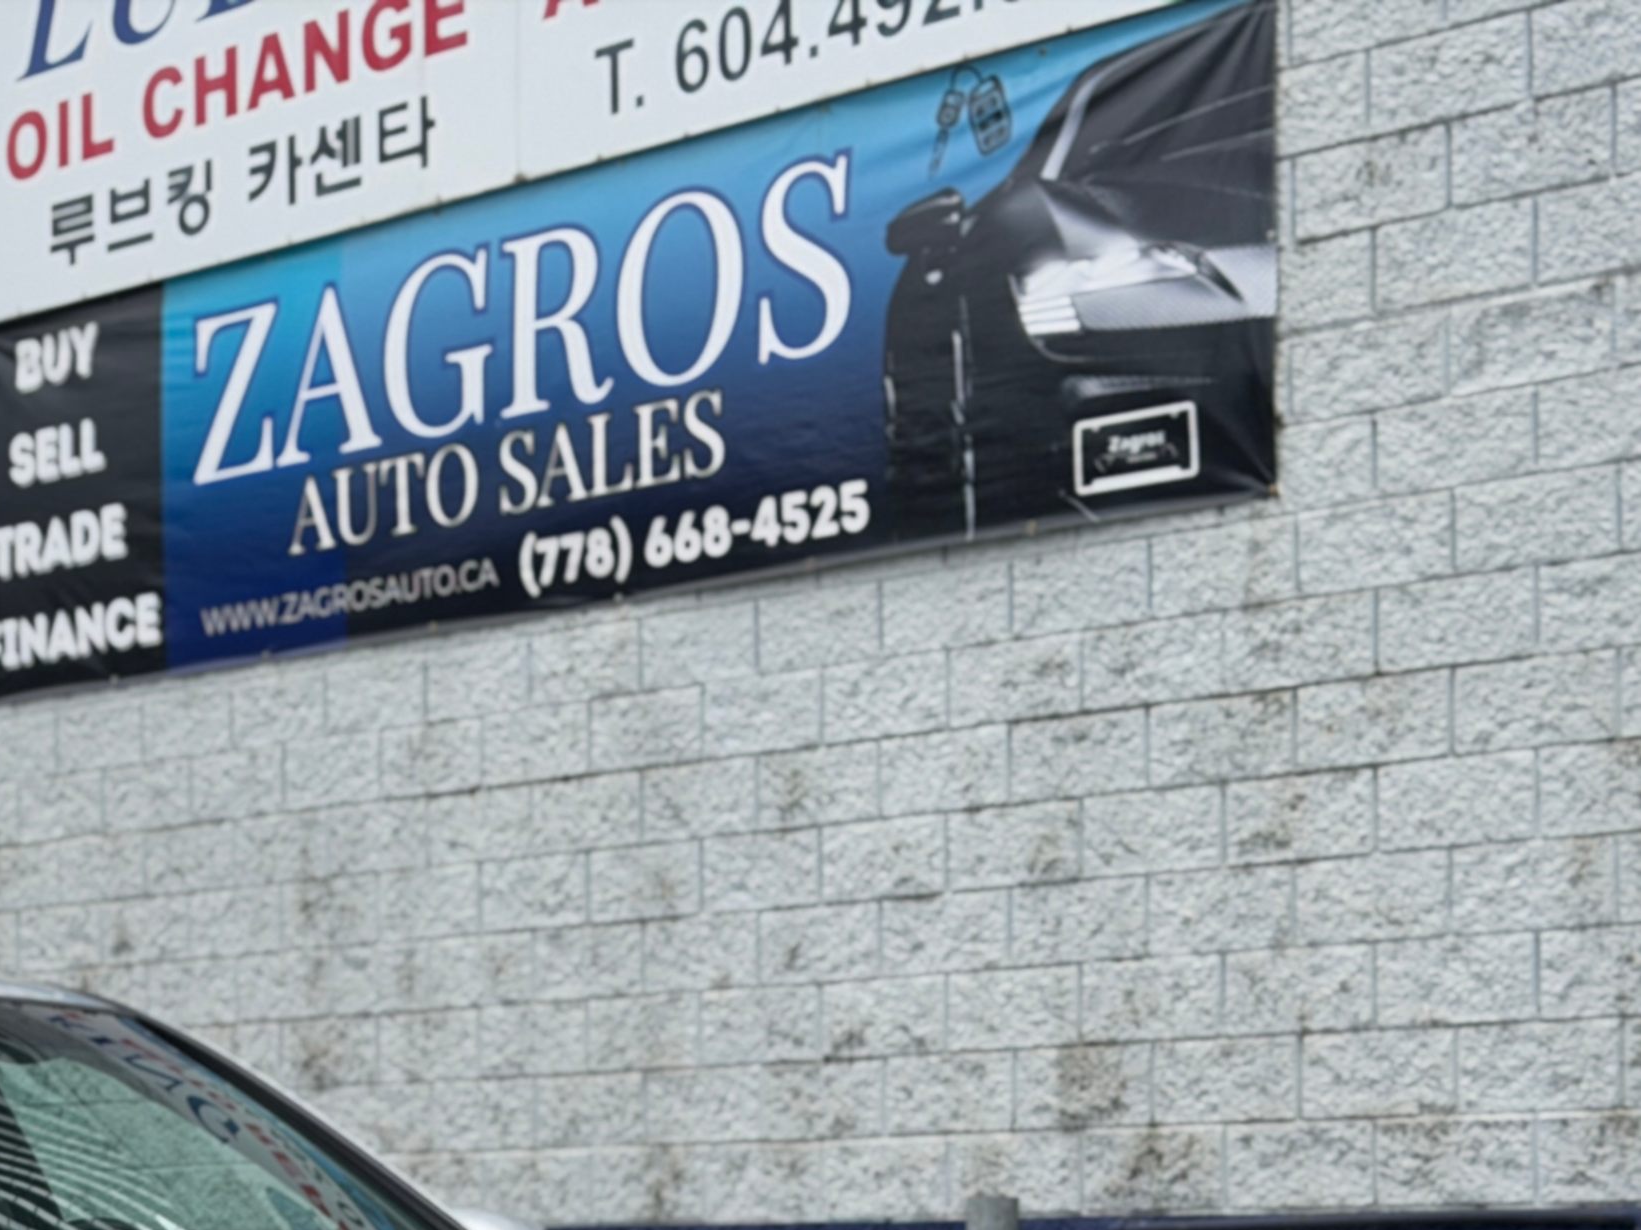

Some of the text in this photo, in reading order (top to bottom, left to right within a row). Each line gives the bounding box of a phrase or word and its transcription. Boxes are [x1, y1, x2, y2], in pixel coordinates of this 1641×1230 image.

[5, 0, 469, 181] OIL CHANGE
[593, 37, 645, 116] T.
[50, 95, 436, 267] 루브킹 카센타
[12, 322, 100, 395] BUY
[193, 154, 851, 487] ZAGROS
[8, 417, 107, 490] SELL
[288, 388, 727, 556] AUTO SALES
[200, 557, 501, 637] WWW.ZAGROSAUTO.CA
[518, 478, 872, 599] (778) 668-4525
